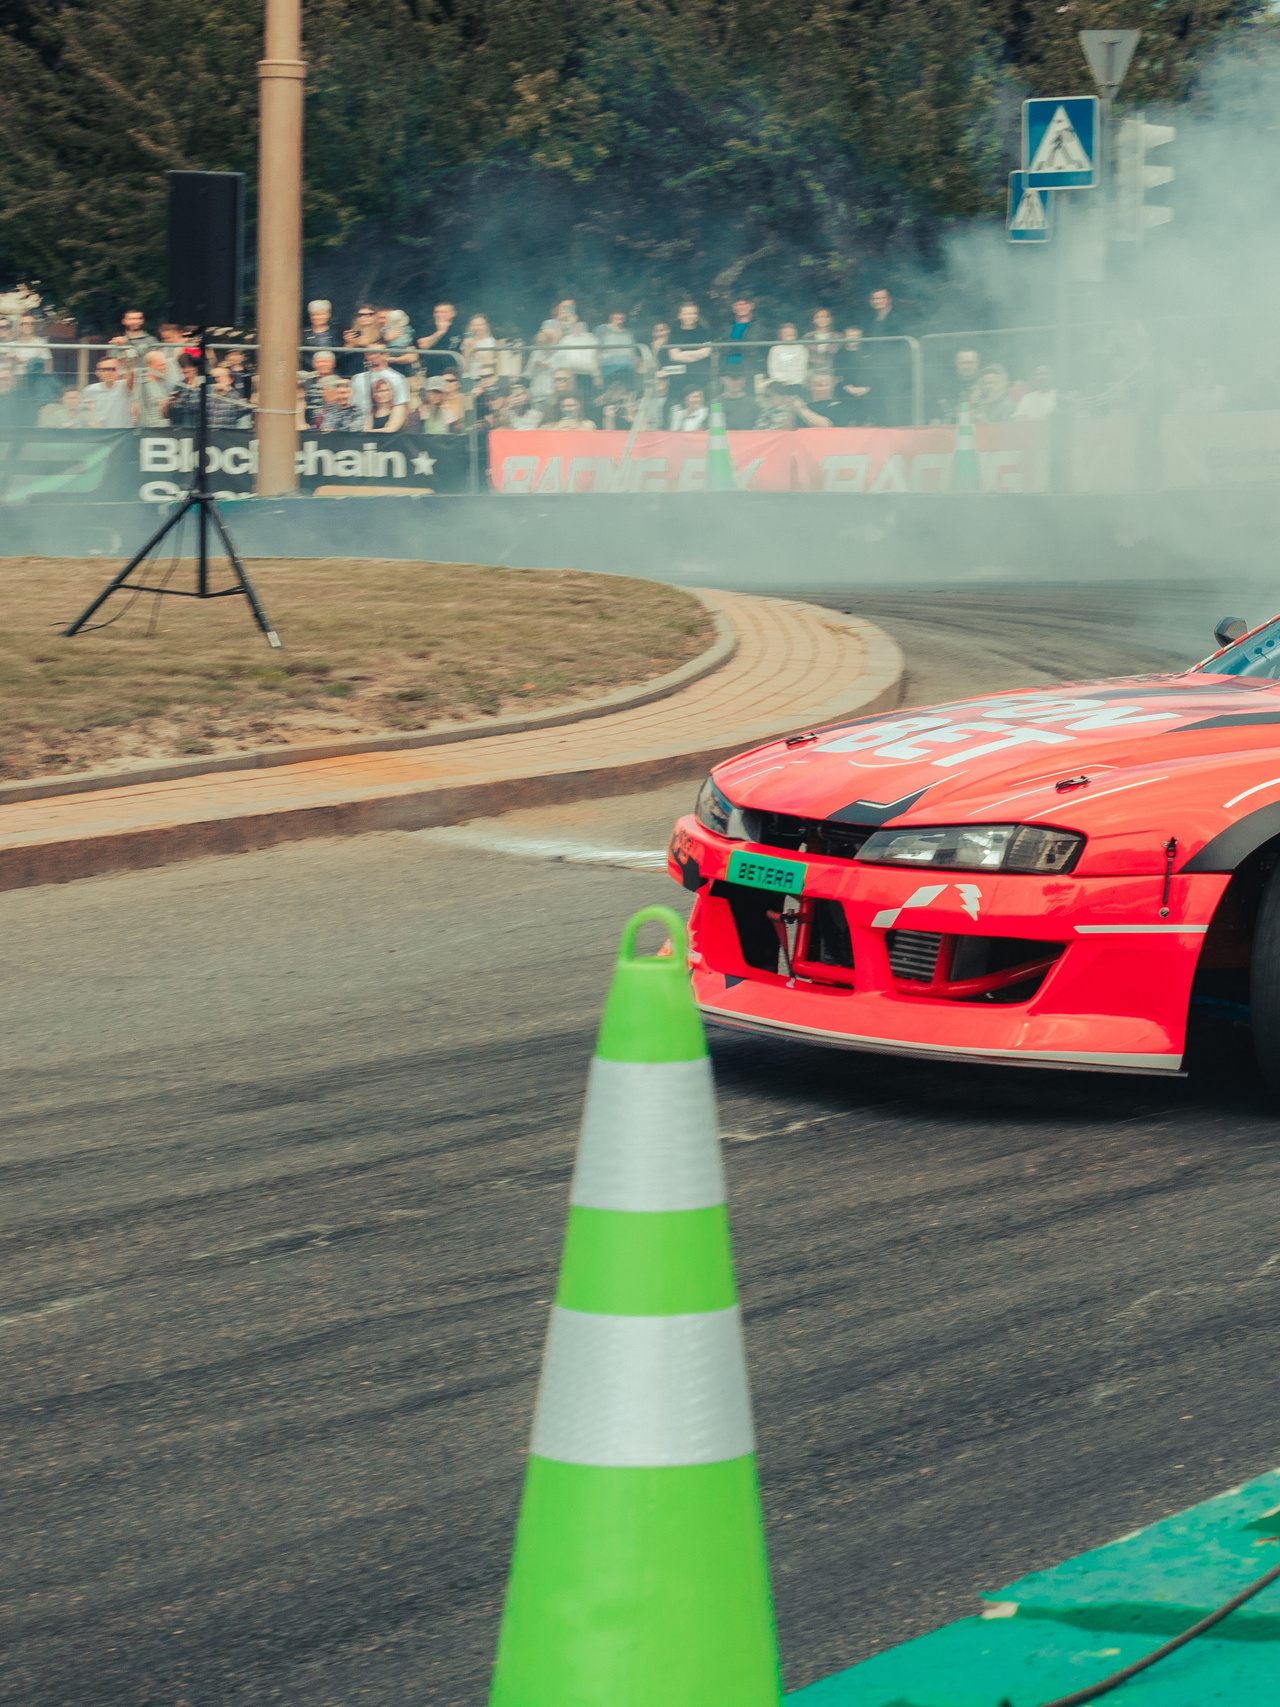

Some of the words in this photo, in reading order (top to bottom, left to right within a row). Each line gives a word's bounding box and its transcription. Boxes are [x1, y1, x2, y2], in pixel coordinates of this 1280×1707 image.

[140, 437, 407, 478] Blochain
[922, 695, 1184, 731] FON
[811, 716, 1078, 767] BET
